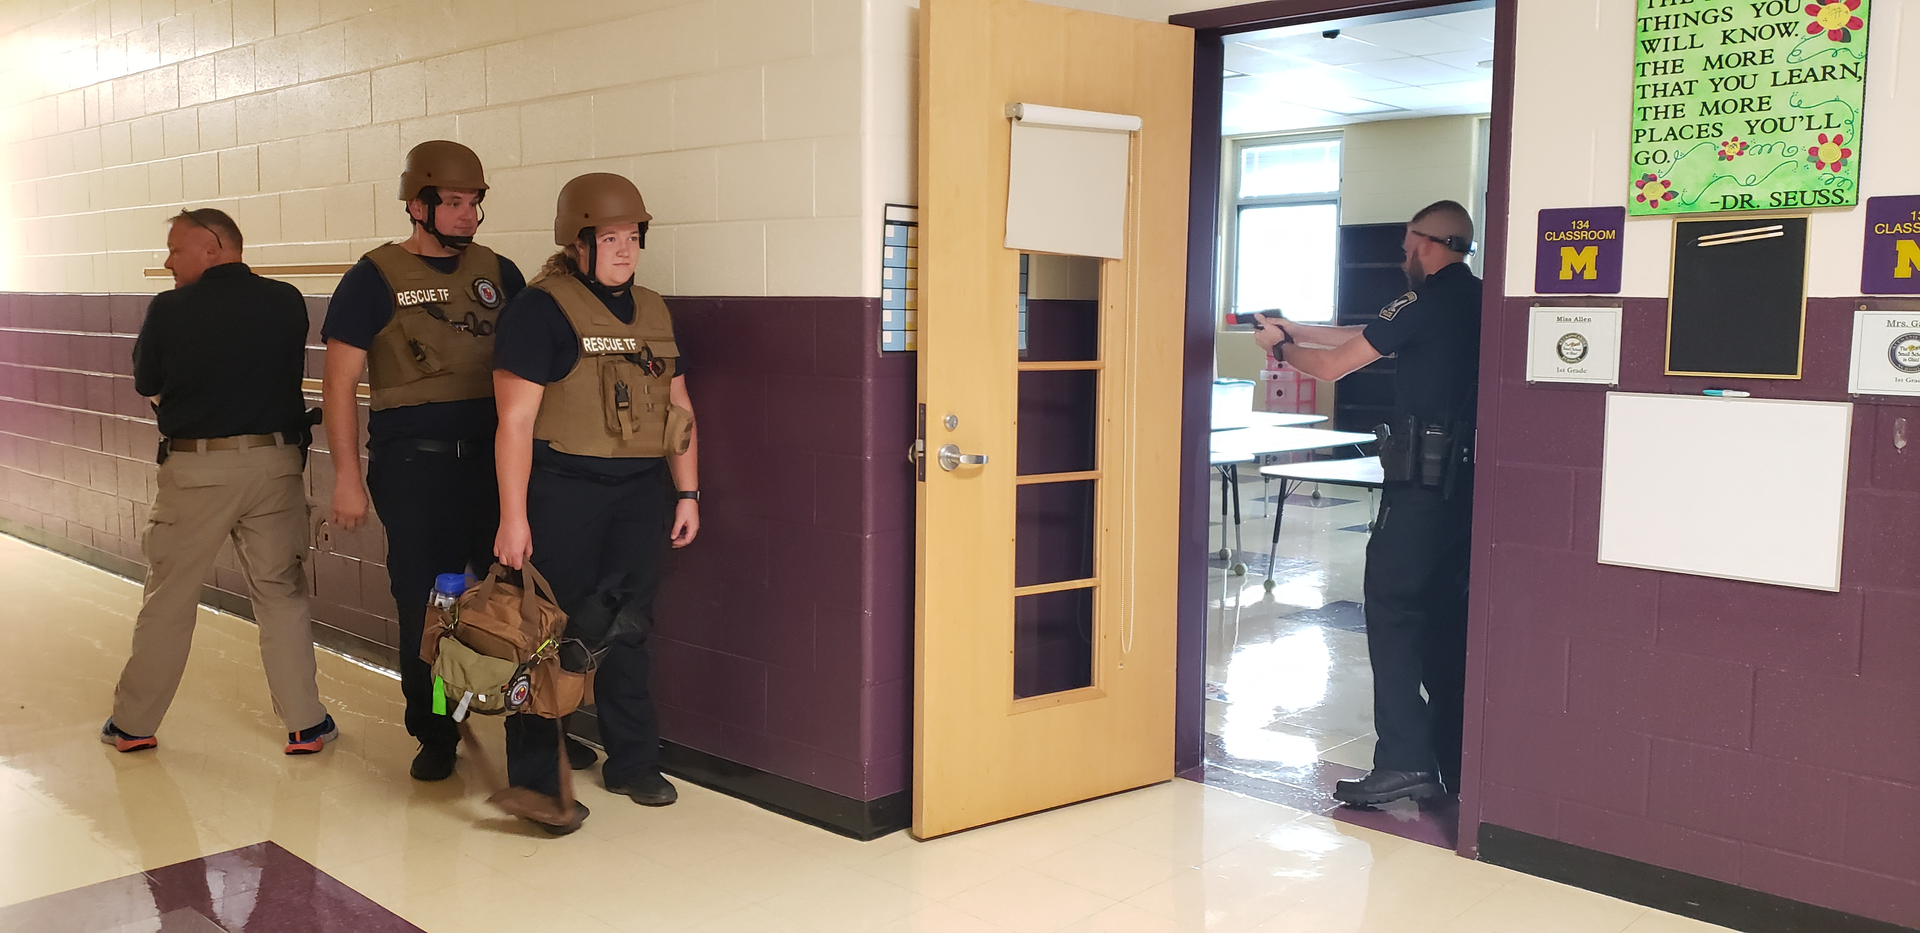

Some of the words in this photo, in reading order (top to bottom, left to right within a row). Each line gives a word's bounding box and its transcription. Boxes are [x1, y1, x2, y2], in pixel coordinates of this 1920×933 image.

[1638, 6, 1733, 33] THINGS
[1751, 0, 1802, 20] YOU
[1641, 34, 1704, 54] WILL
[1721, 21, 1799, 46] KNOW.
[1636, 58, 1685, 77] THE
[1703, 49, 1774, 71] MORE
[1636, 80, 1698, 100] THAT
[1708, 74, 1758, 93] YOU
[1770, 62, 1863, 88] LEARN,
[1638, 103, 1686, 121] THE
[1699, 96, 1772, 117] MORE
[1634, 123, 1723, 144] PLACES
[1745, 113, 1841, 135] YOU'LL
[1634, 149, 1671, 166] GO.
[1769, 189, 1849, 207] SEUSS.
[1571, 220, 1589, 229] 134
[1544, 230, 1616, 241] CLASSROOM
[1559, 246, 1598, 280] M
[397, 289, 438, 306] RESCUE
[437, 288, 449, 301] TF
[1886, 319, 1909, 328] Mrs.
[583, 337, 625, 352] RESCUE
[623, 338, 637, 350] TF
